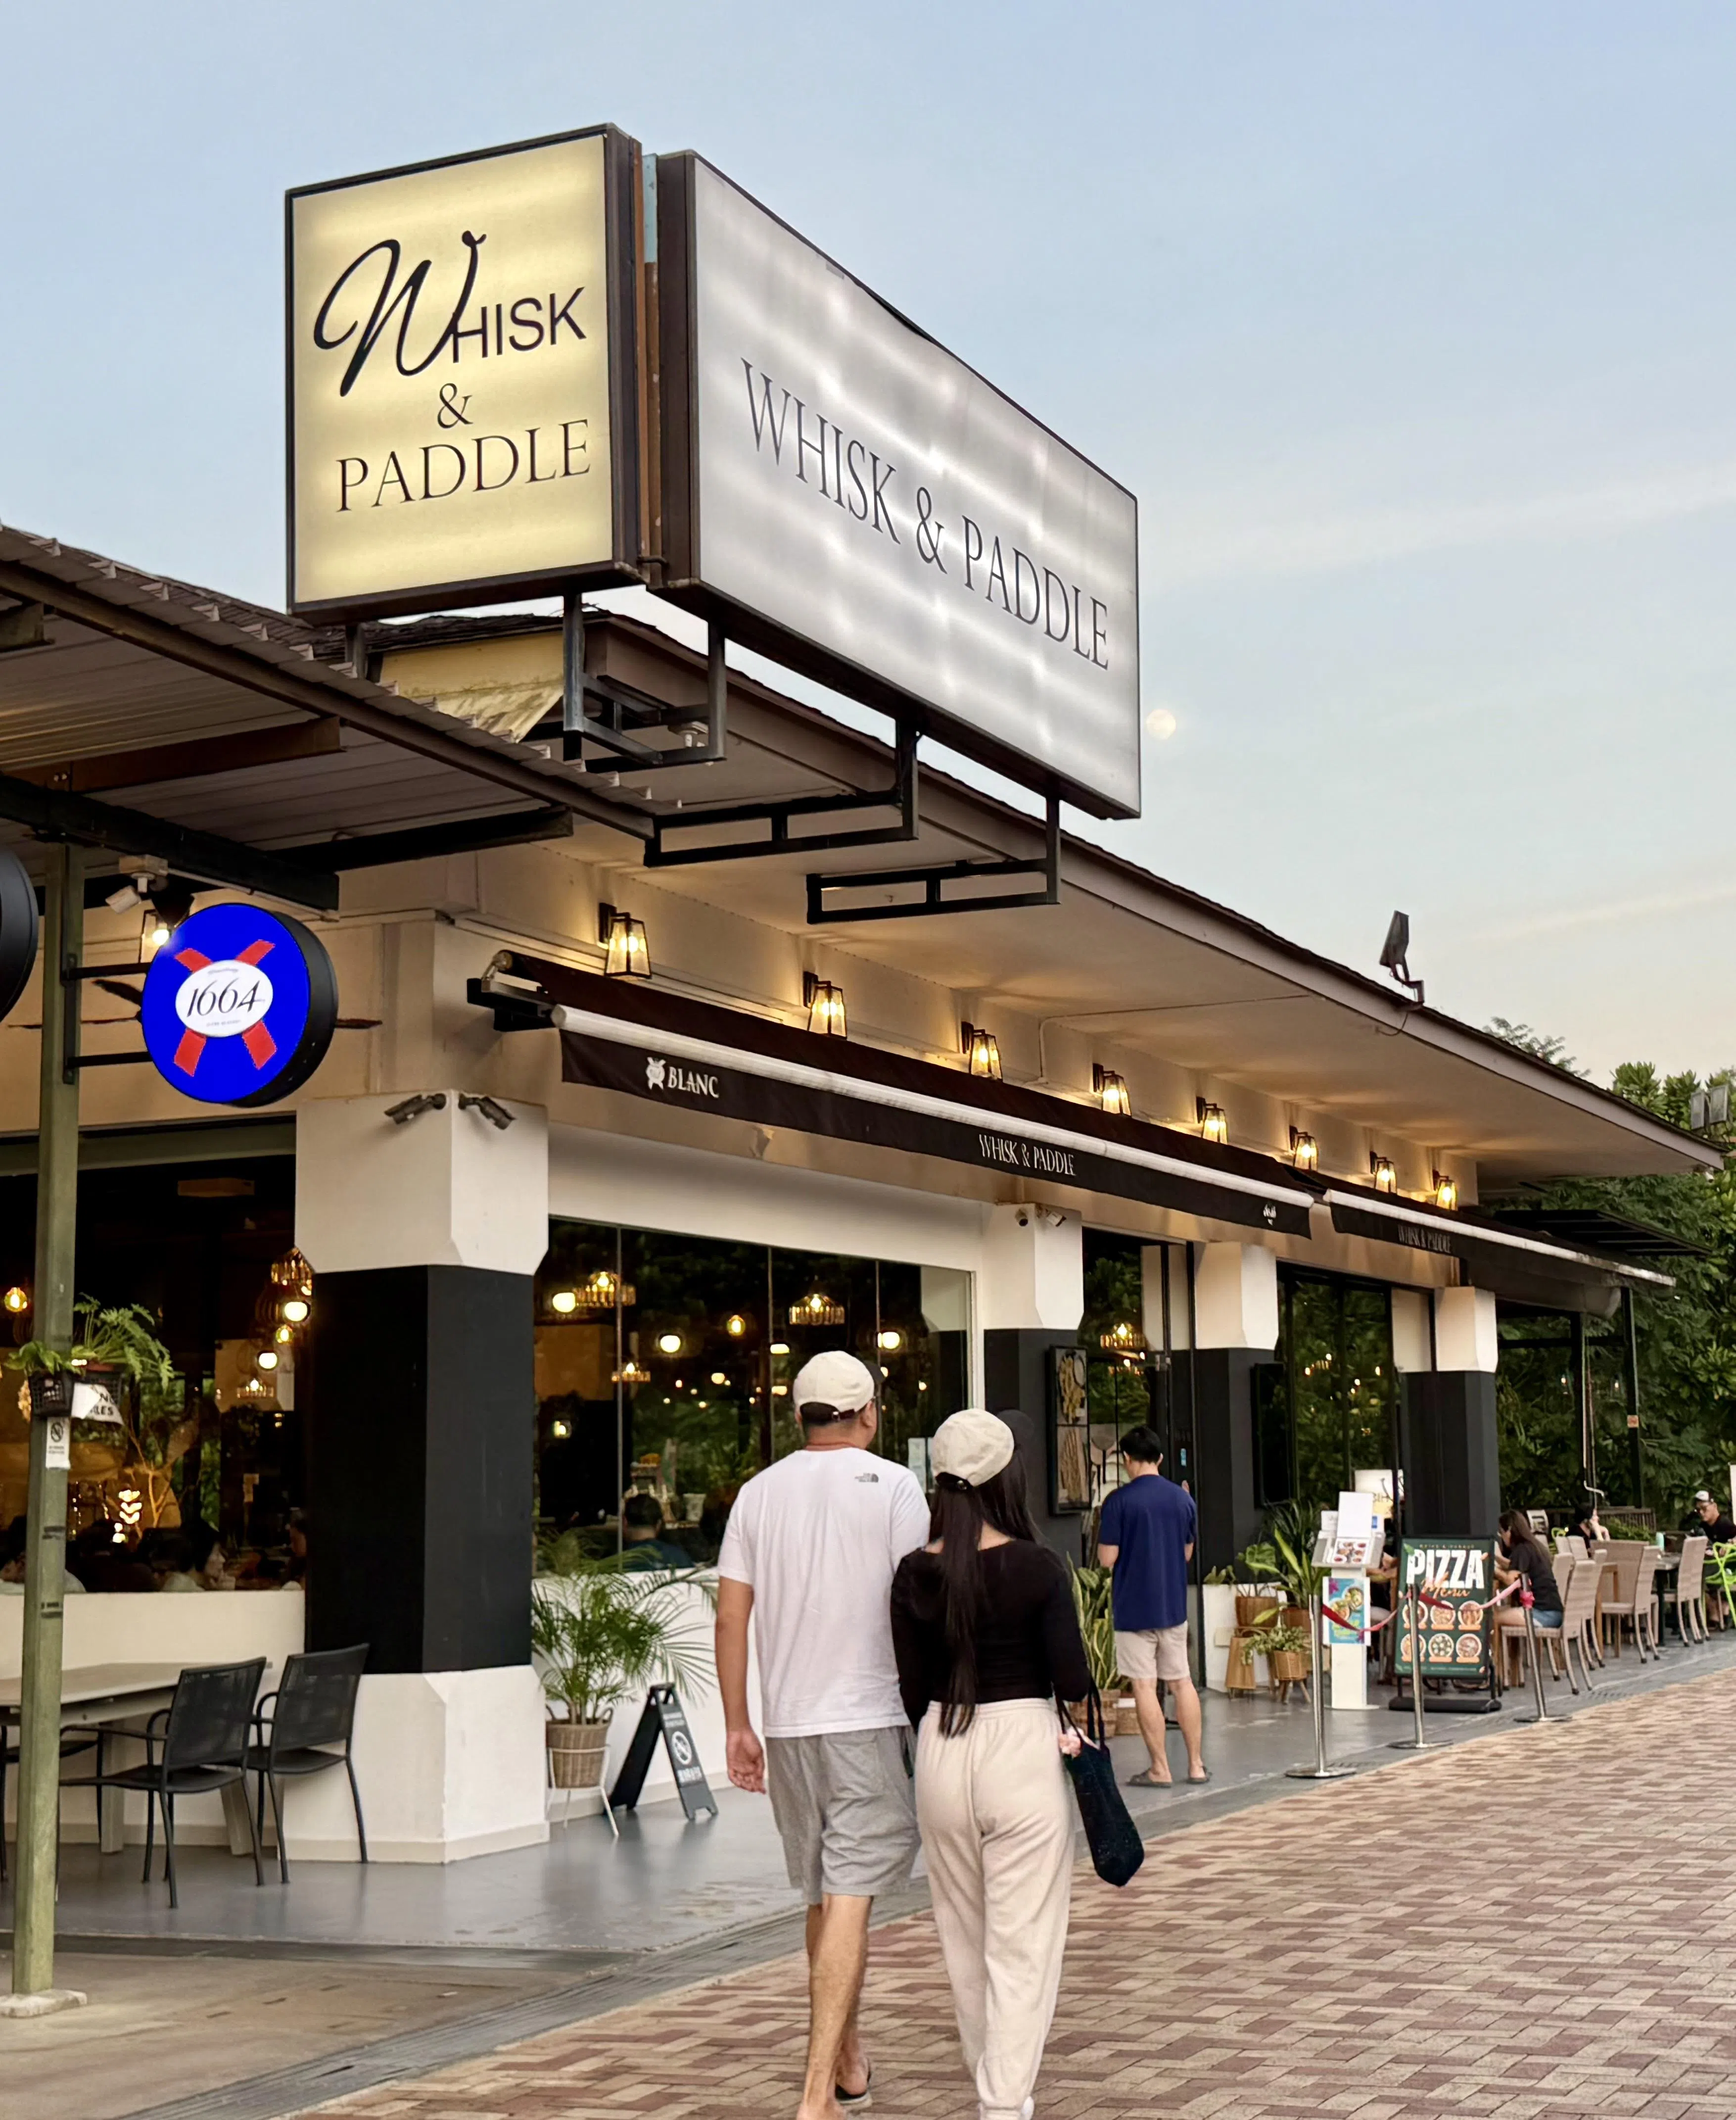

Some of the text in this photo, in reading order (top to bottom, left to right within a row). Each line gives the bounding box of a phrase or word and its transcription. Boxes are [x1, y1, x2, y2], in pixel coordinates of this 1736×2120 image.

[313, 230, 587, 397] WHISK
[437, 383, 473, 429] &
[335, 419, 591, 513] PADDLE
[741, 357, 1109, 671] WHISK & PADDLE
[186, 977, 266, 1017] 1664
[667, 1066, 719, 1098] BLANC
[979, 1134, 1076, 1176] WHISK & PADDLE
[1406, 1549, 1484, 1589] PIZZA
